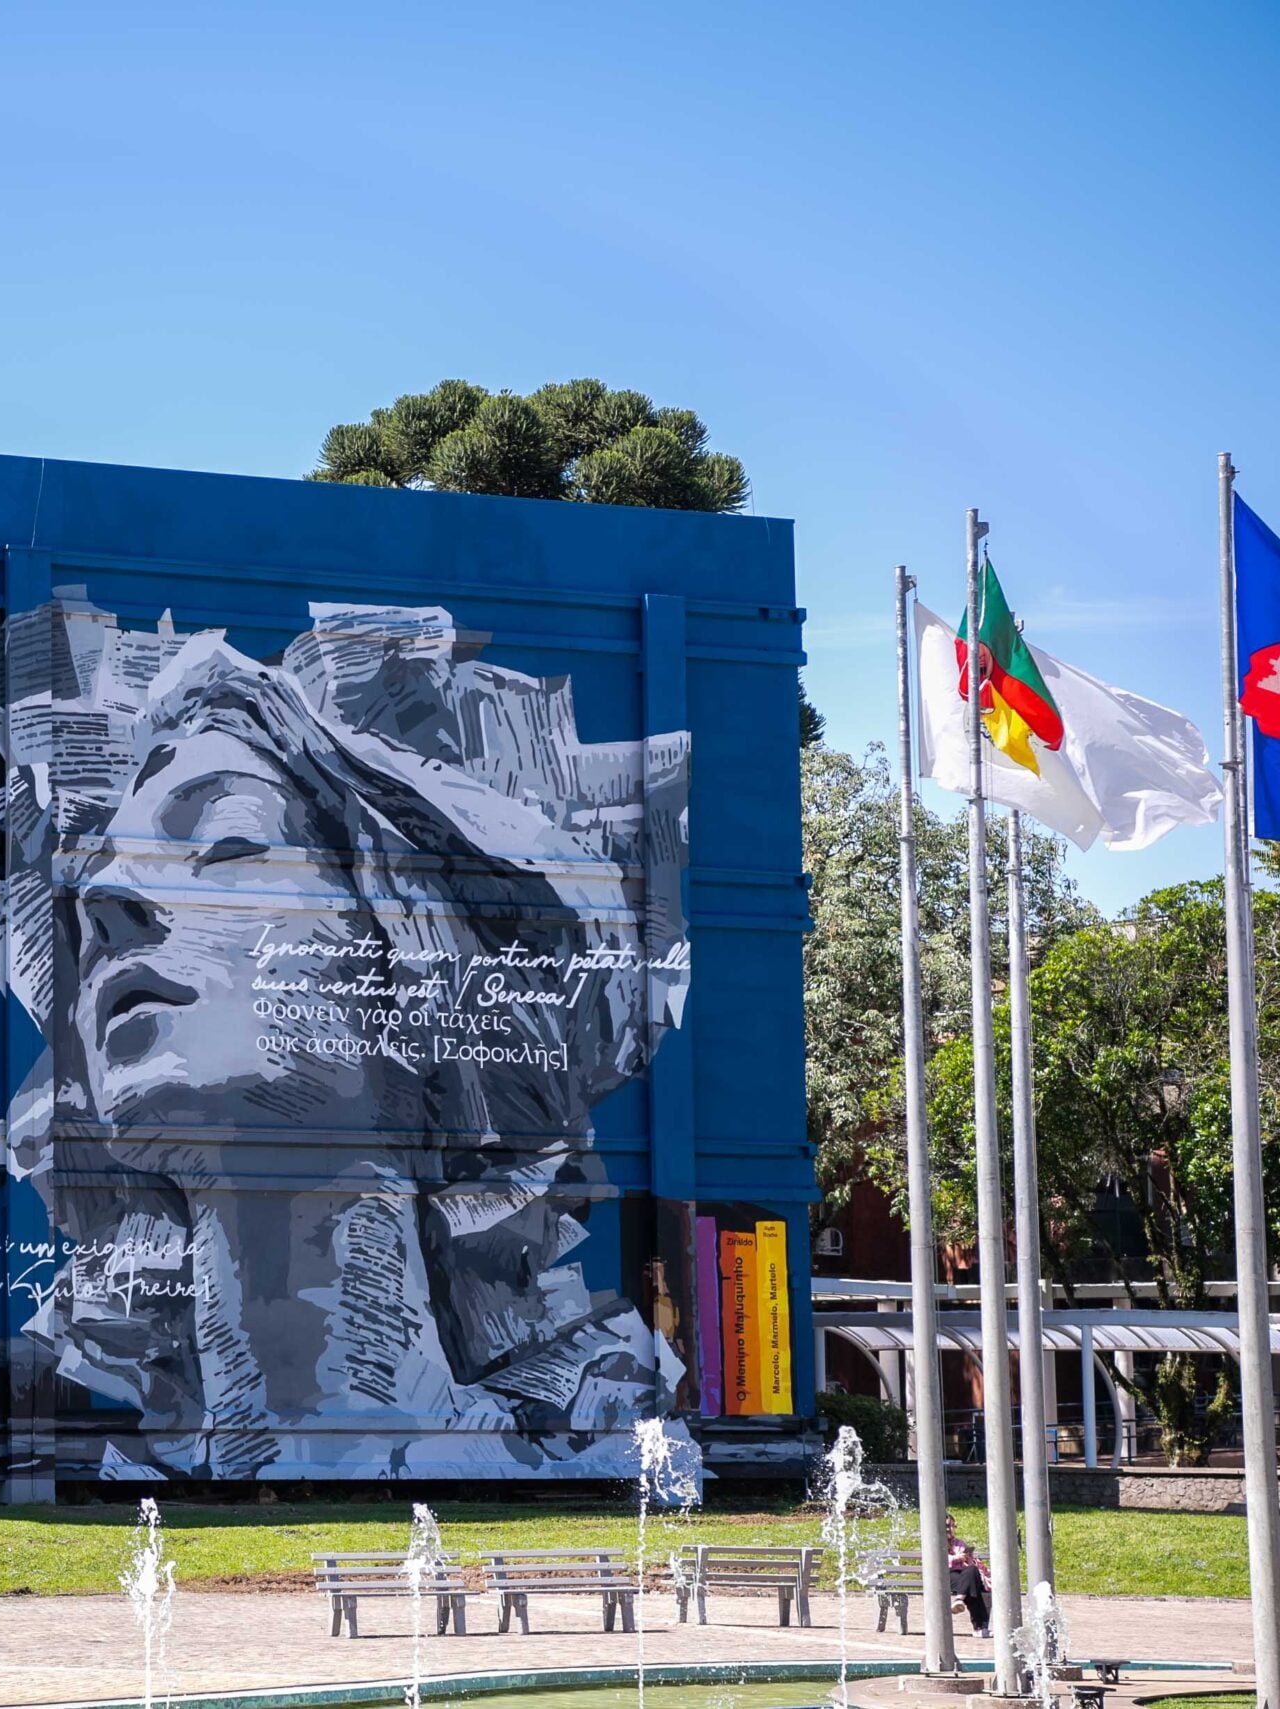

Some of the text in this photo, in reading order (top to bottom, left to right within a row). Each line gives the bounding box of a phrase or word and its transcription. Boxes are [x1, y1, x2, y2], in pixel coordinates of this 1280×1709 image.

[249, 924, 383, 968] Ignoranti
[387, 945, 461, 968] quem
[461, 940, 564, 981] portum
[563, 943, 637, 982] petat
[319, 968, 397, 997] ventus
[62, 1237, 206, 1276] exigência
[726, 1237, 753, 1247] Ziraldo
[768, 1263, 778, 1300] Martelo
[734, 1257, 747, 1401] O Menino Maluquinho
[772, 1351, 781, 1394] Marcelo,
